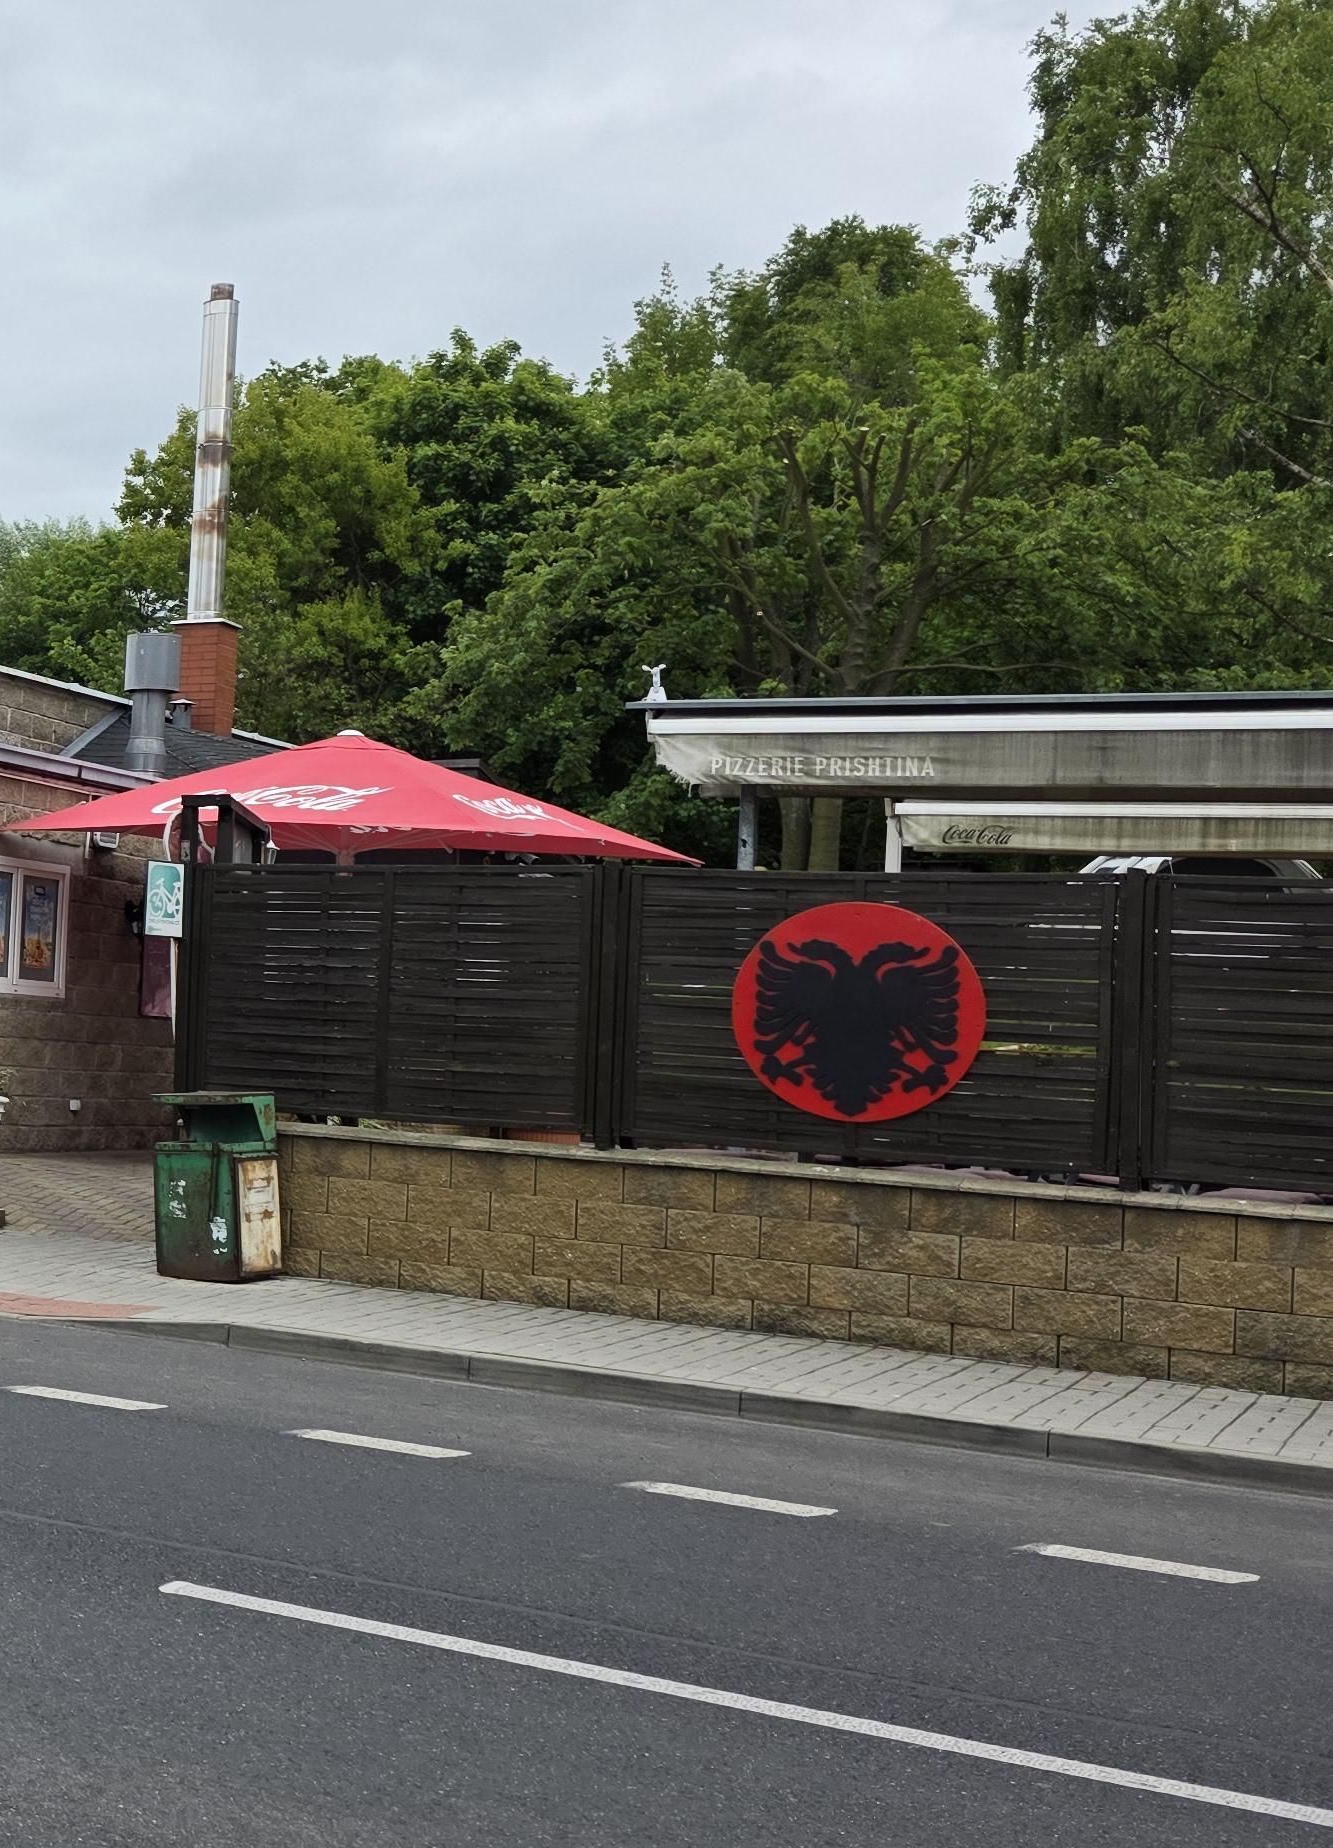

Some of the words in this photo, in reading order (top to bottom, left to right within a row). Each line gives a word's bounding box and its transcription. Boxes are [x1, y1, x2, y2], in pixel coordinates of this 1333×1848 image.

[710, 756, 805, 777] PIZZERIE
[814, 755, 936, 778] PRISHTINA
[151, 784, 395, 814] Ca-Cola
[941, 823, 1016, 846] Coca-Cola
